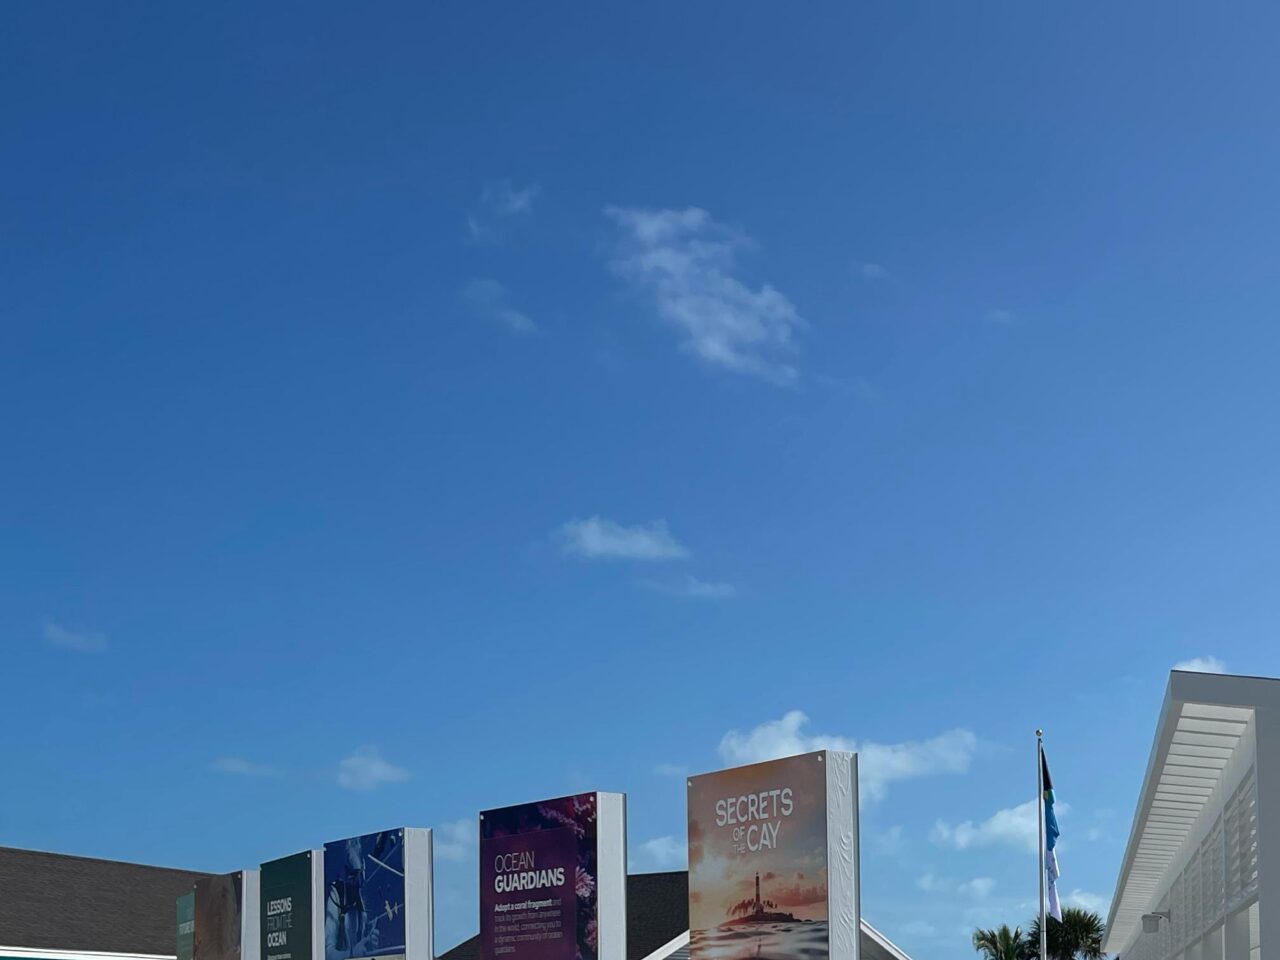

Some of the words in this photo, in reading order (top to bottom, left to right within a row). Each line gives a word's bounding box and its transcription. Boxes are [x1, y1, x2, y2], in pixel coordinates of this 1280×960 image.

[715, 788, 794, 827] SECRETS
[732, 826, 745, 842] OF
[747, 821, 781, 852] CAY
[494, 851, 535, 873] OCEAN
[494, 867, 565, 894] GUARDIANS
[267, 897, 292, 916] LESSONS
[267, 930, 287, 948] OCEAN
